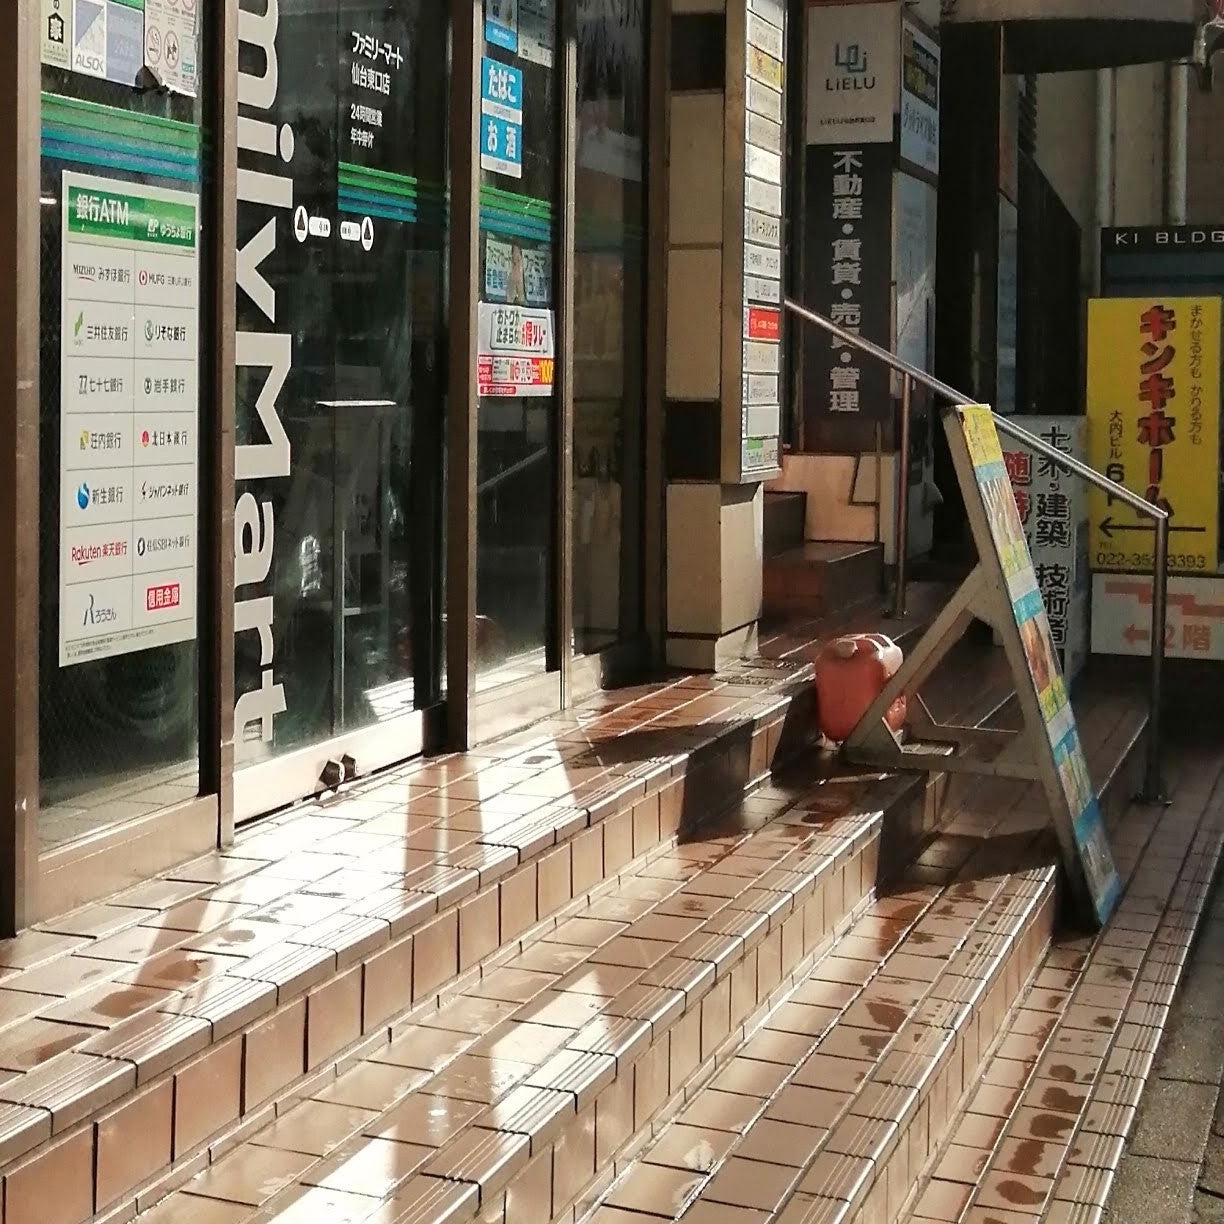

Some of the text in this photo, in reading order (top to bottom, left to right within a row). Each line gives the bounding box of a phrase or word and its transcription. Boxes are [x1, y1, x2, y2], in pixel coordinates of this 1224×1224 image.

[352, 31, 403, 69] ファミリーマート
[75, 53, 104, 73] ALSOK
[352, 62, 390, 95] 仙台東口店
[488, 64, 517, 103] たばこ
[351, 103, 383, 127] 24時間営業
[351, 127, 374, 148] 年中無休
[76, 193, 129, 226] 銀行ATM
[160, 222, 192, 240] ゆうちょ銀行
[1116, 233, 1138, 245] KI
[73, 264, 130, 283] MIZUHO みずほ銀行
[149, 273, 165, 285] MUFG
[87, 325, 128, 342] 三井住友銀行
[155, 326, 186, 342] りそな銀行
[89, 378, 123, 393] 七十七銀行
[154, 378, 185, 394] 岩手銀行
[1137, 305, 1176, 518] キンキホーム
[91, 432, 121, 450] 荘内銀行
[152, 431, 187, 447] 北日本銀行
[92, 486, 123, 505] 新生銀行
[148, 483, 189, 499] ジャパンネット銀行
[72, 541, 127, 563] Rakuten 楽天銀行
[147, 535, 190, 552] 住信SBIネット銀行
[148, 587, 180, 608] 信用金庫
[95, 608, 117, 624] ろうきん
